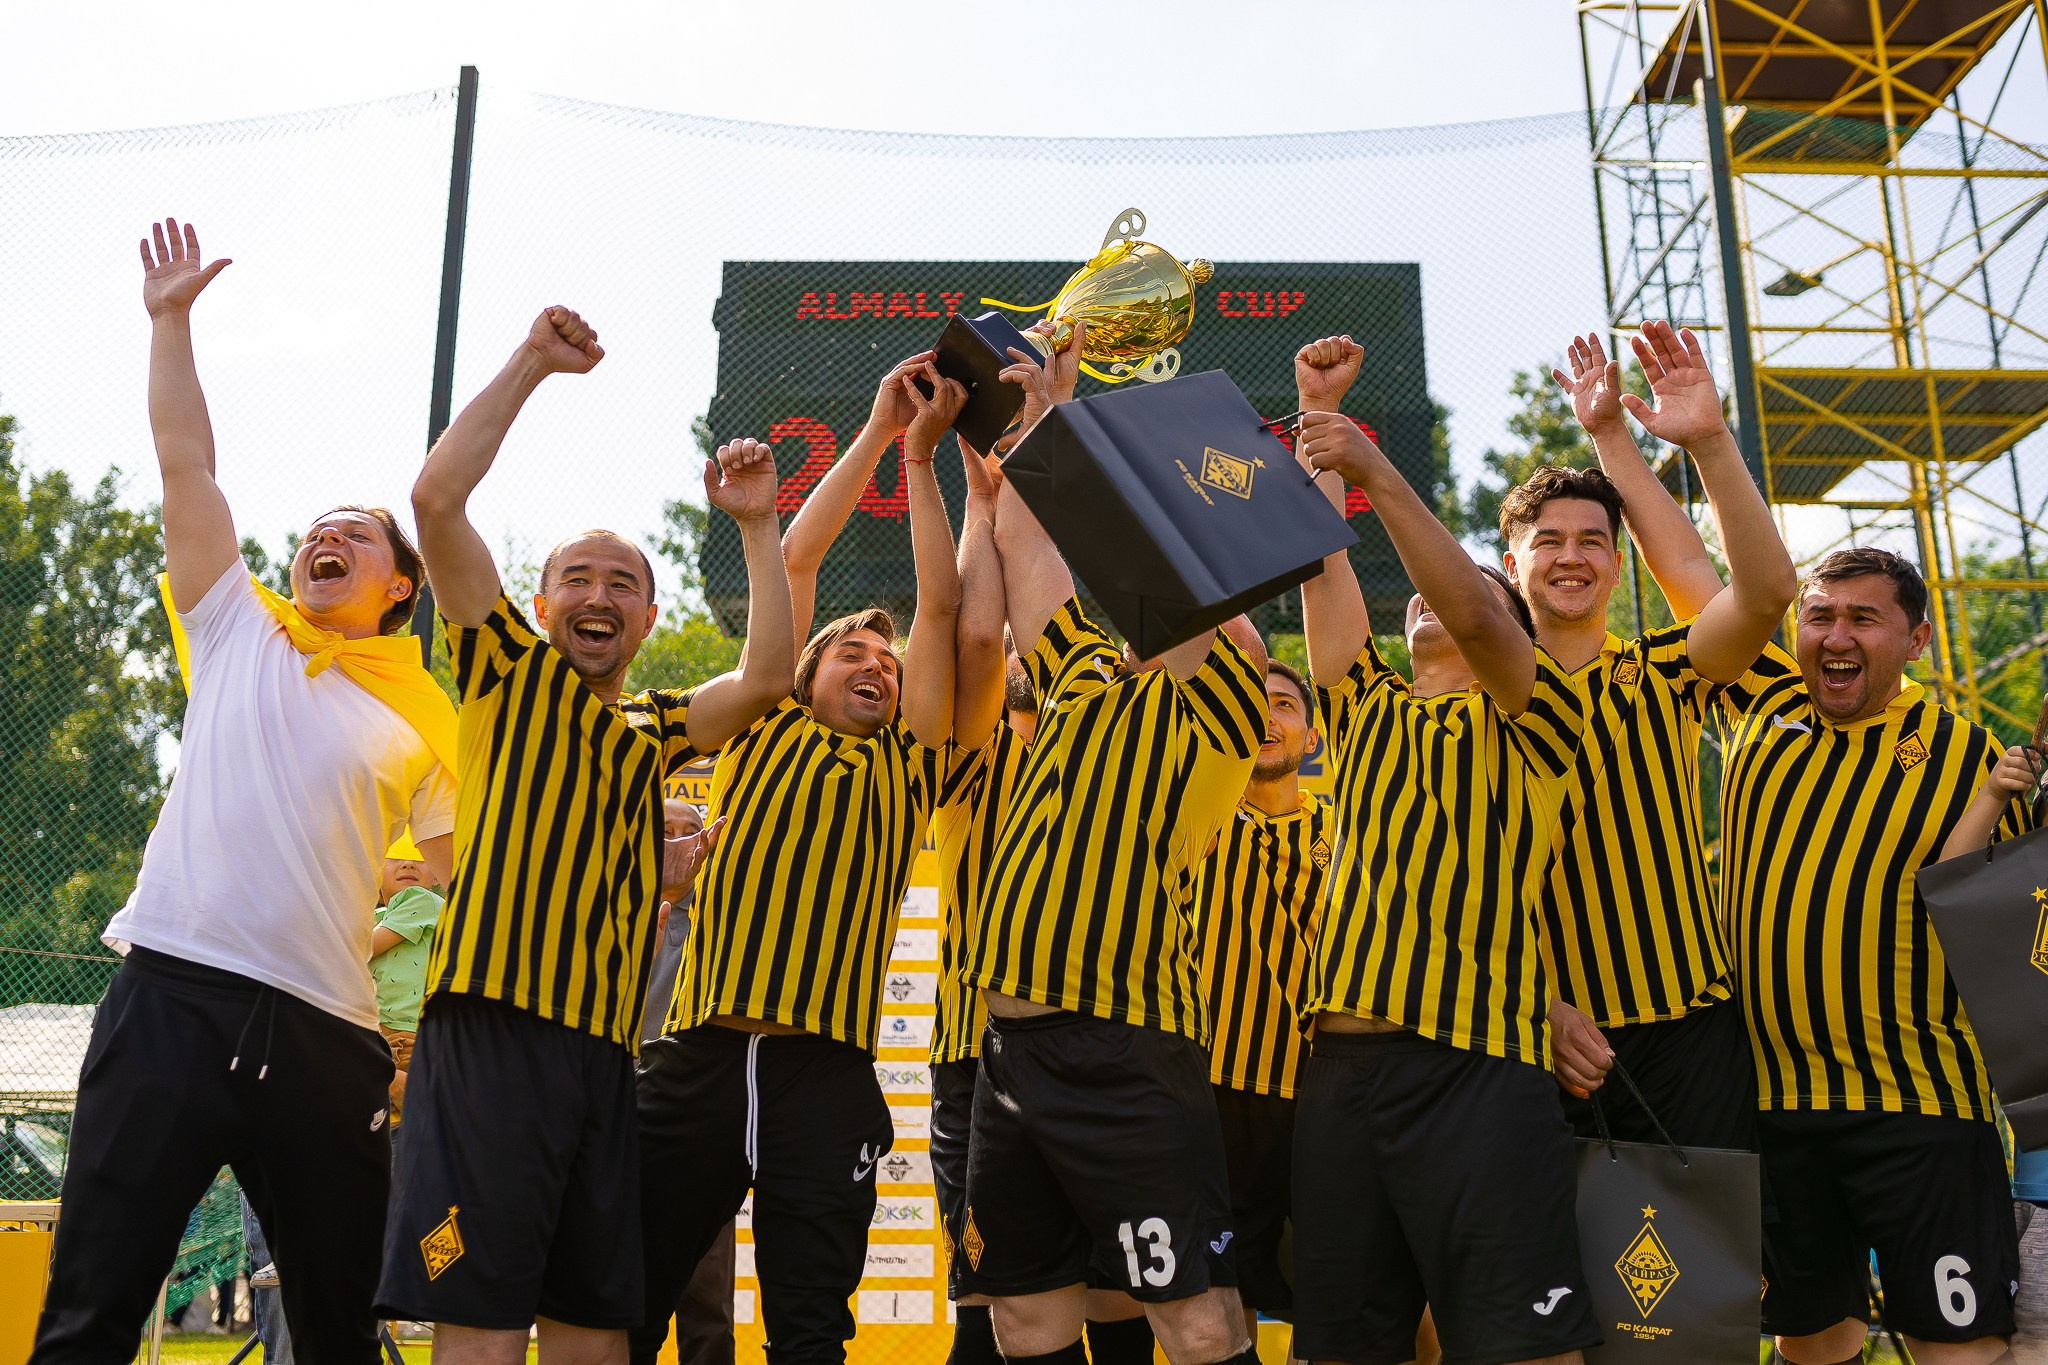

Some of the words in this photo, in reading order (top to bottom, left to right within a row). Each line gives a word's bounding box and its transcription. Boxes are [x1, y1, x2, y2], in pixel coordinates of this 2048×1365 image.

[796, 292, 965, 319] ALMALY
[1216, 291, 1305, 317] CUP
[1118, 1217, 1176, 1288] 13
[1623, 1264, 1670, 1279] КАЙРАТ
[1934, 1255, 1977, 1326] 6
[1616, 1322, 1631, 1331] FC
[1633, 1323, 1673, 1336] KAIRAT
[1633, 1332, 1656, 1341] 1954
